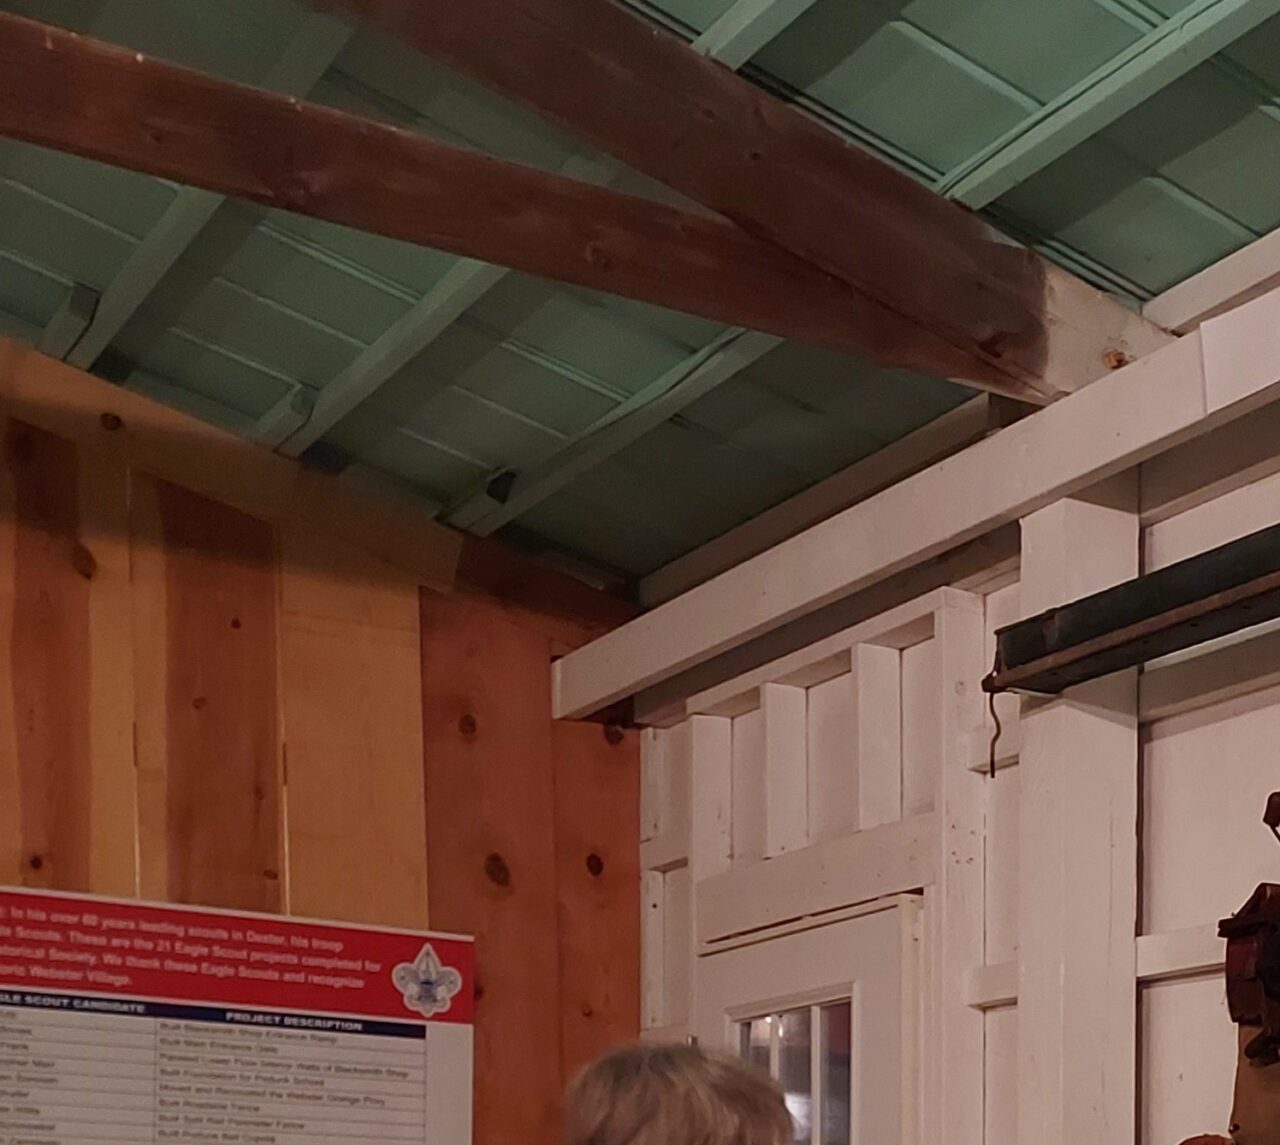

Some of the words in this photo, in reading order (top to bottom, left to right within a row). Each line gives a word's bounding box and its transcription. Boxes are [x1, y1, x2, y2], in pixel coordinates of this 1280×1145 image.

[174, 940, 209, 957] Eagle
[24, 995, 70, 1007] SCOUT
[72, 998, 145, 1013] CANDIDATE
[225, 1011, 282, 1025] PROJECT
[283, 1015, 363, 1031] DESCRIPTION
